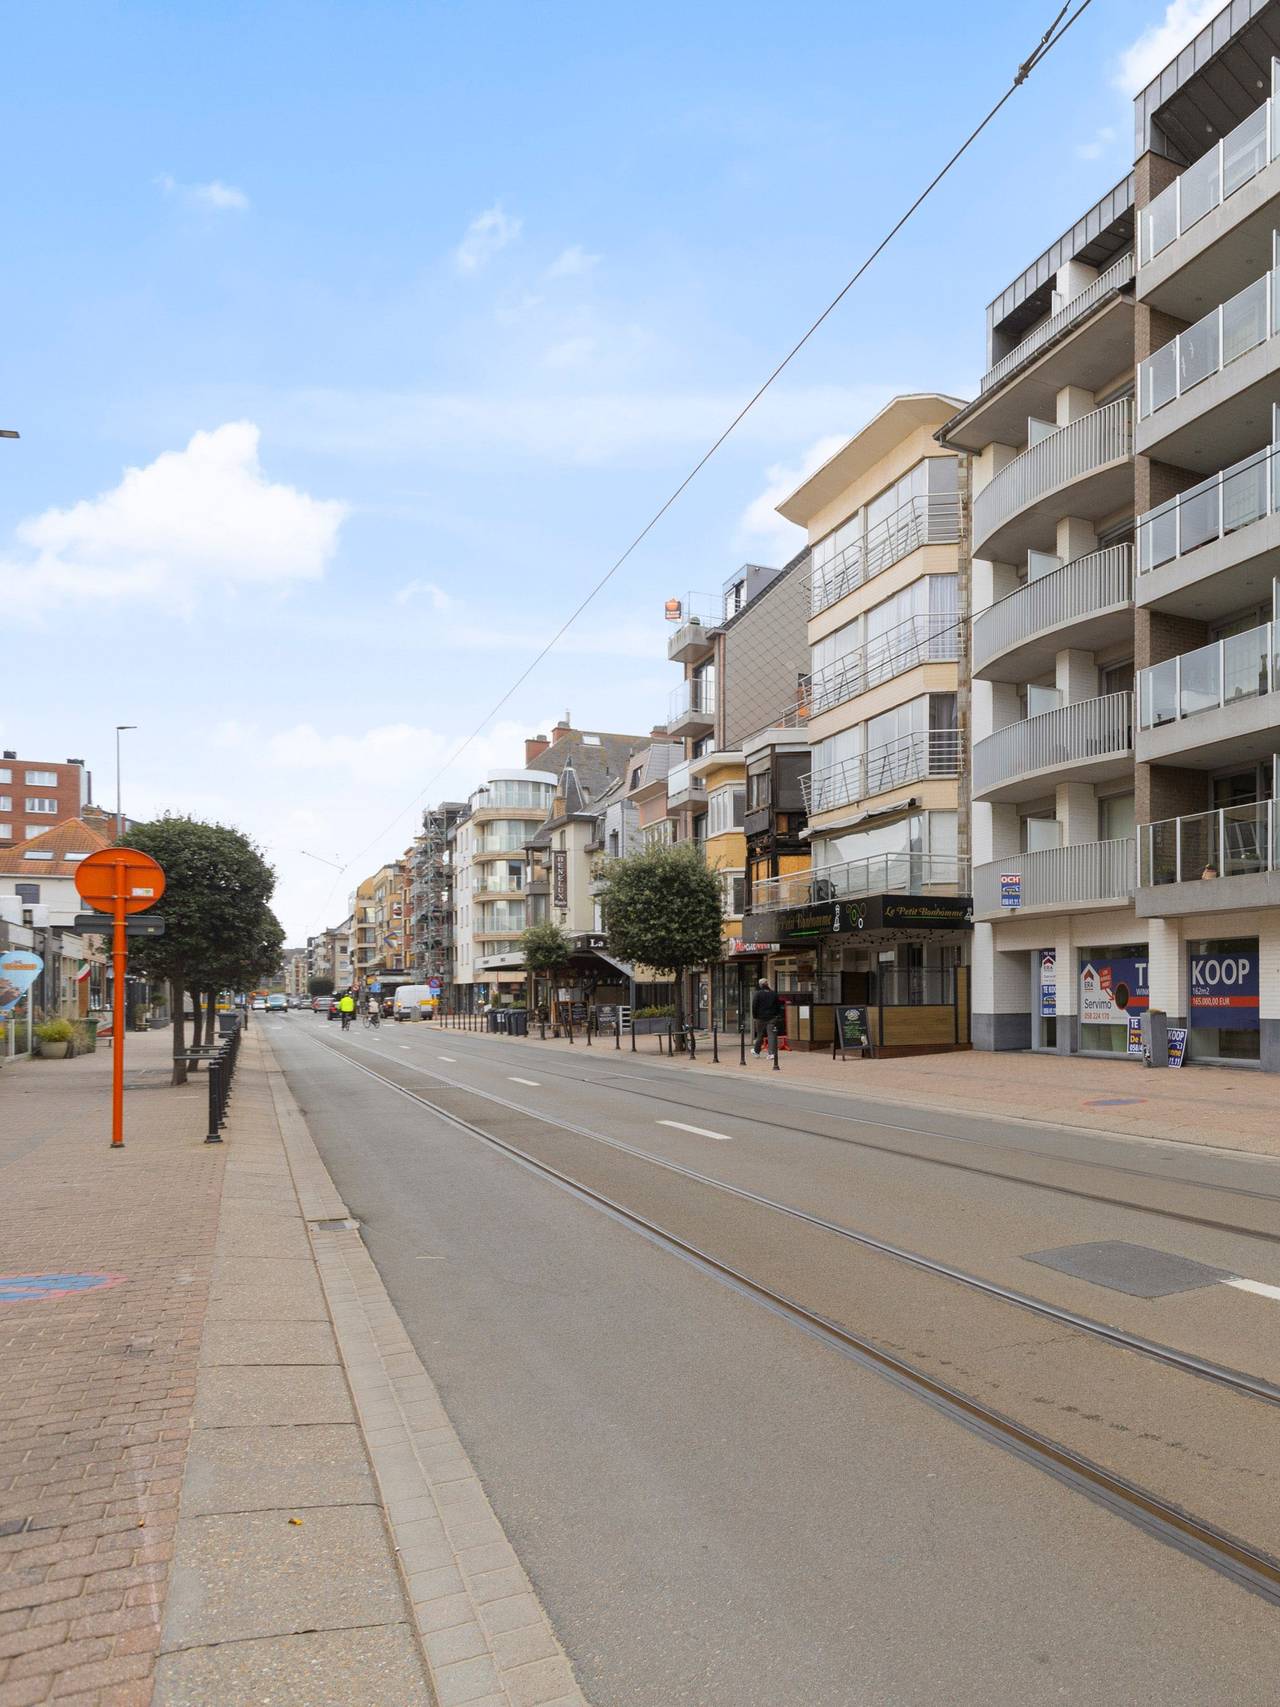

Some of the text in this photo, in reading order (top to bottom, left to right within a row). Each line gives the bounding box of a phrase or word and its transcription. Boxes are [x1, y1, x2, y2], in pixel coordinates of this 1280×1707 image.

[1135, 963, 1149, 986] T
[1192, 958, 1250, 985] KOOP
[1084, 981, 1094, 989] ERA
[1084, 998, 1112, 1010] Servimo
[1130, 1019, 1139, 1028] TE
